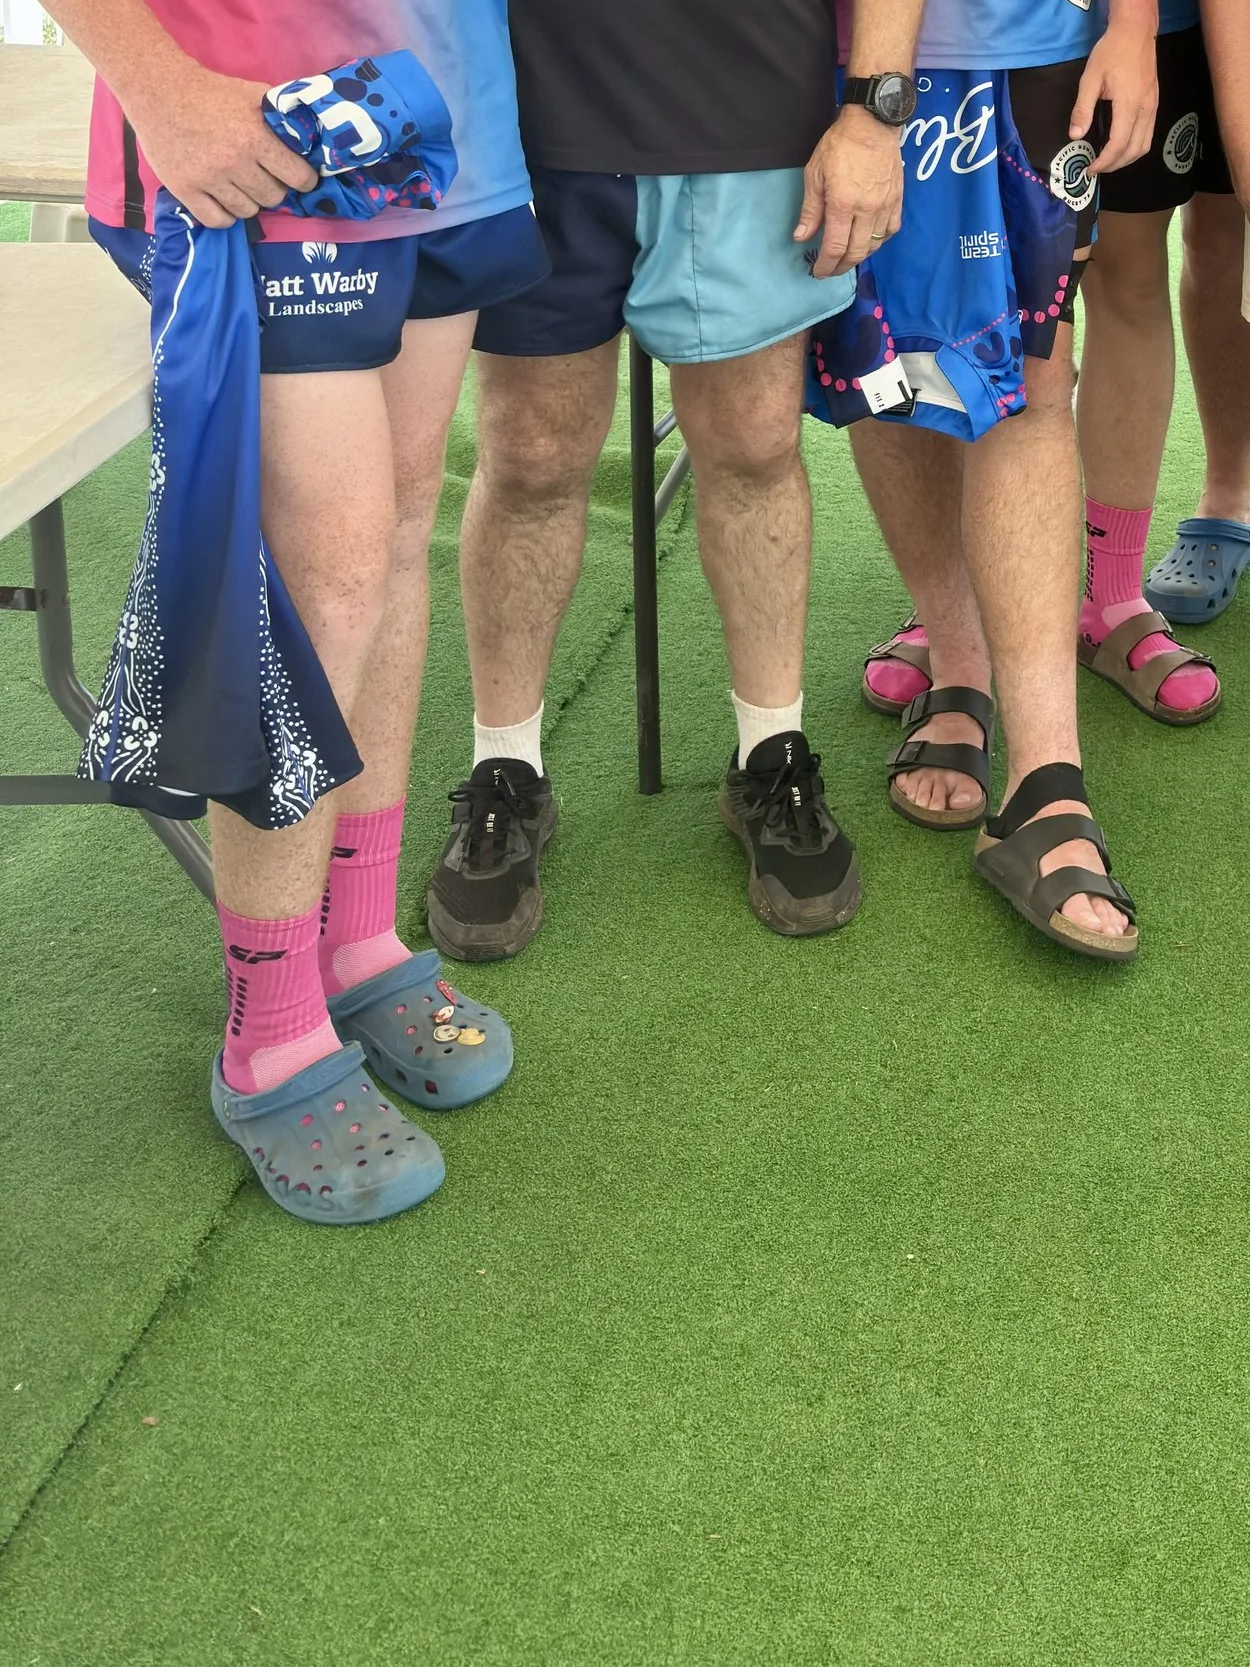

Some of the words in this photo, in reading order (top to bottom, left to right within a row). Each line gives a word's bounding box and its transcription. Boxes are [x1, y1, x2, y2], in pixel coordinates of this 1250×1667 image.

[260, 274, 305, 297] att
[310, 268, 379, 295] Warby
[268, 298, 365, 317] Landscapes
